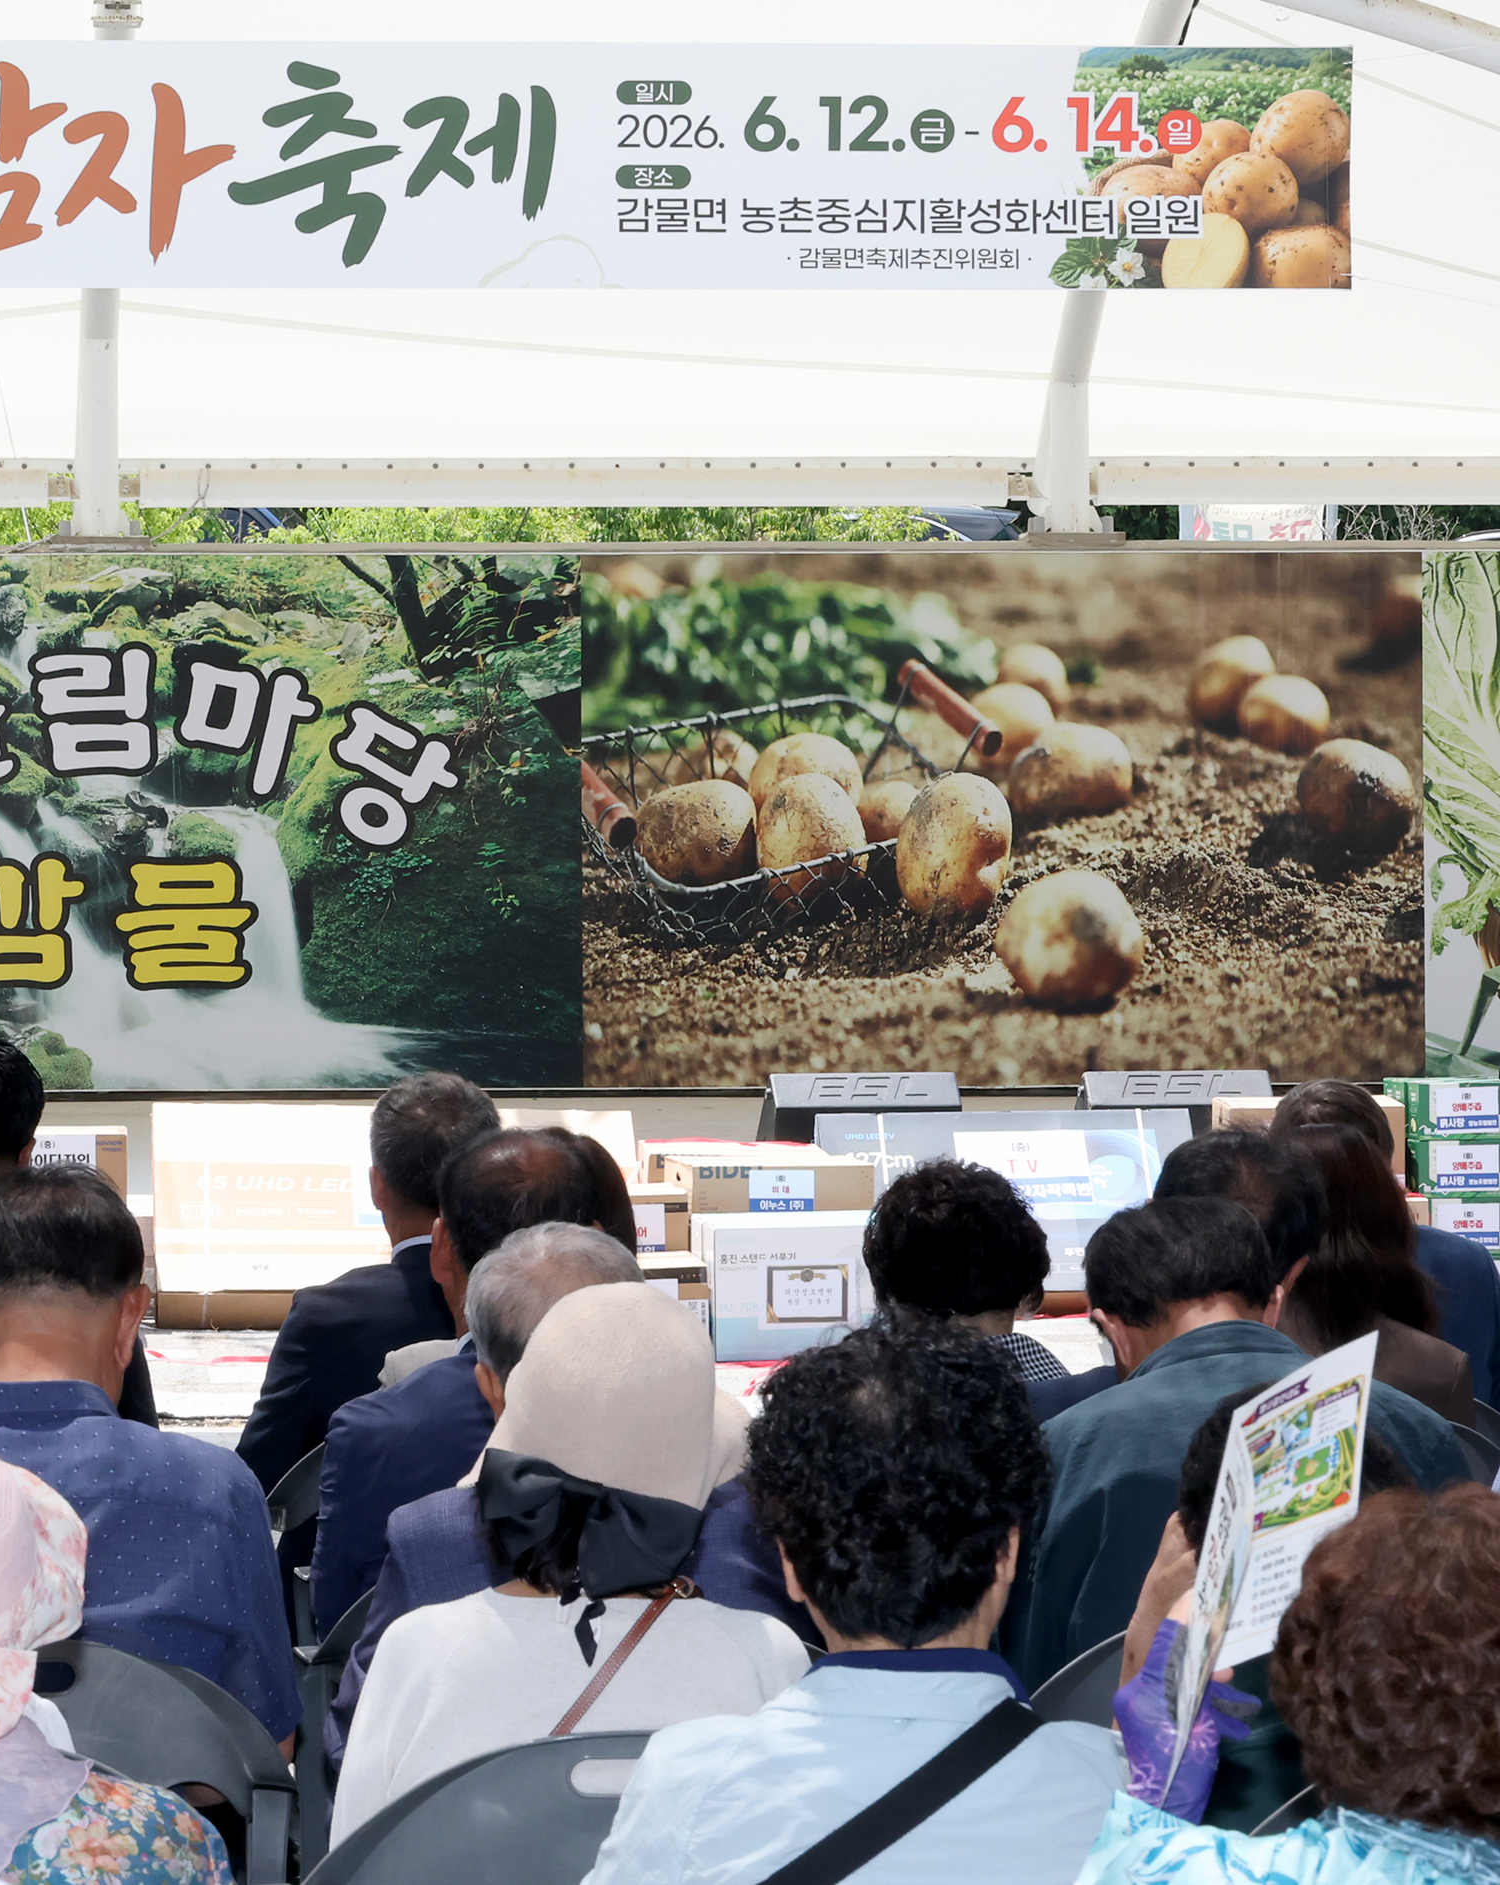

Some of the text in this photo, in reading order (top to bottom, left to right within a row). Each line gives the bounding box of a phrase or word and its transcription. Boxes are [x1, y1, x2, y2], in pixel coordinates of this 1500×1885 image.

[634, 82, 675, 103] 일시
[616, 113, 725, 150] 2026.
[743, 96, 799, 153] 6.
[992, 97, 1047, 153] 6.
[228, 61, 556, 268] 축제
[634, 167, 674, 187] 장소
[617, 197, 1202, 236] 감물면 농촌중심지활성화센터 일원
[1439, 1118, 1465, 1128] 흙사랑
[31, 1153, 90, 1166] 이디자인
[699, 1166, 763, 1179] BIDE
[197, 1175, 354, 1193] 65 UHD LED
[1439, 1176, 1466, 1186] 흙사랑
[759, 1199, 786, 1210] 이누스
[720, 1254, 737, 1264] 홍진
